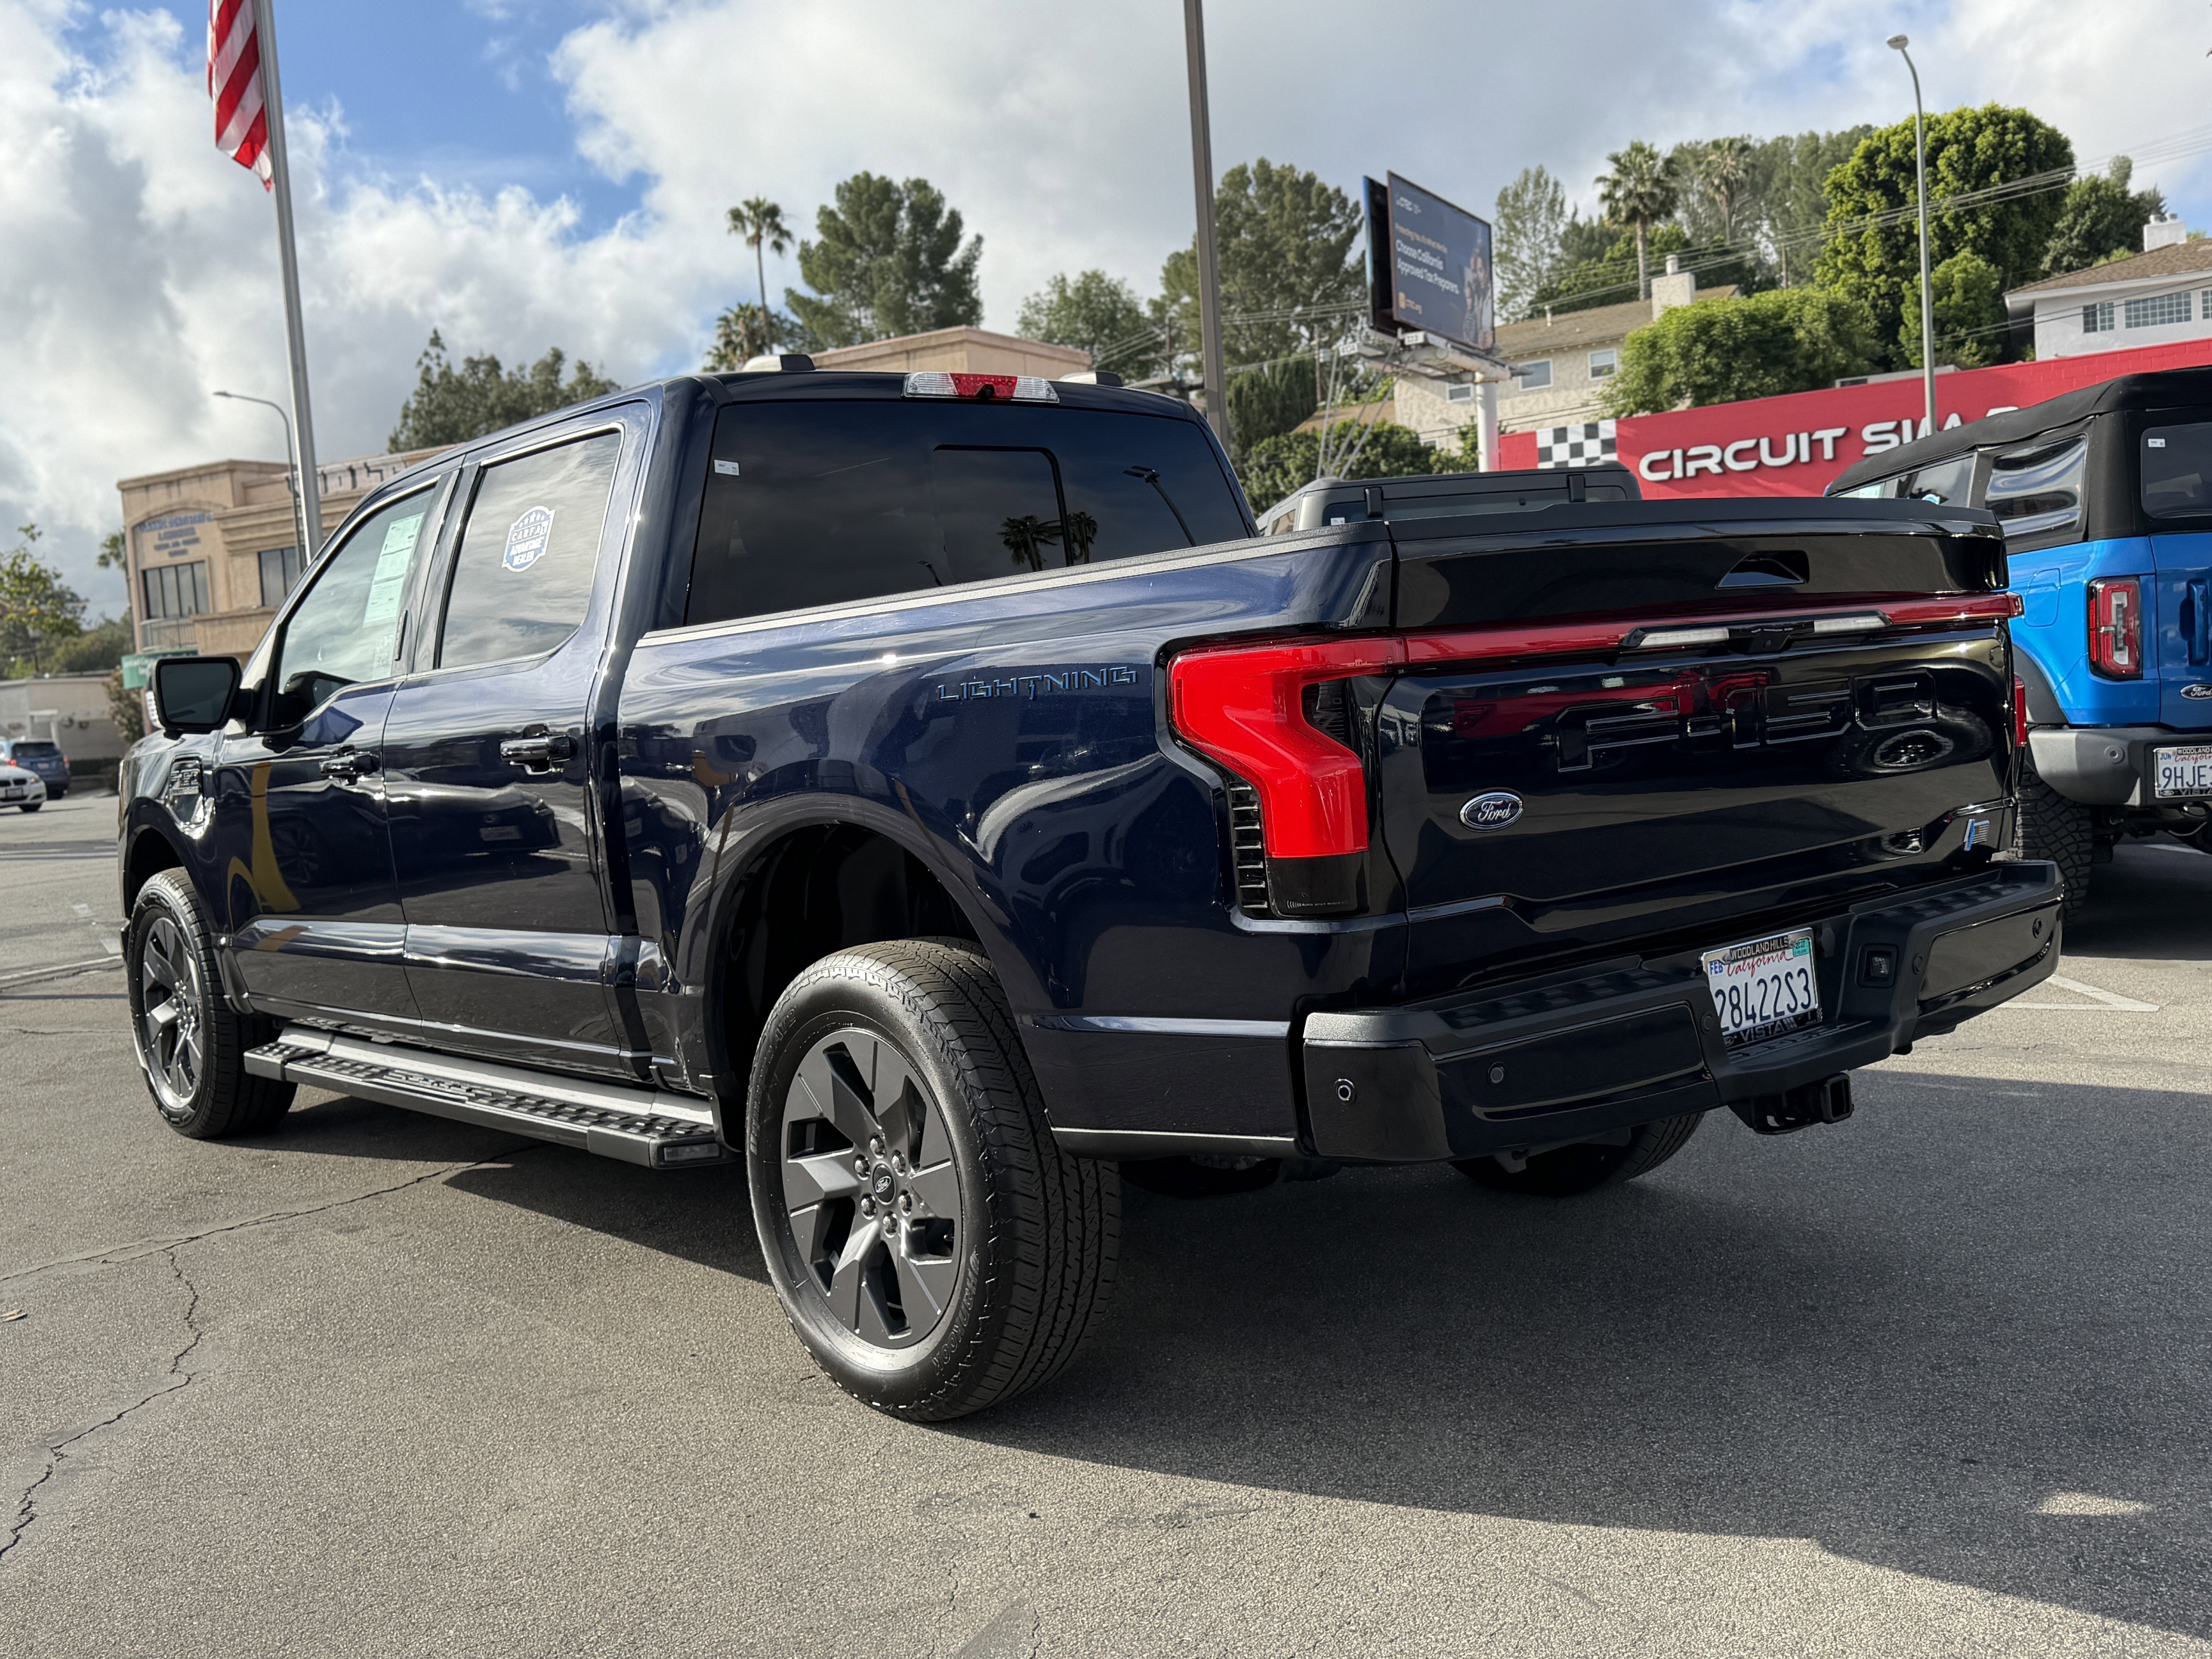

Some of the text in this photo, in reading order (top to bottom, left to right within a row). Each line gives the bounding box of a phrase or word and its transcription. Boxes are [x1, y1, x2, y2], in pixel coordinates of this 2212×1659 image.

[1638, 427, 1848, 481] CIRCUIT
[512, 521, 549, 542] CARFAX
[937, 666, 1137, 702] LIGHTNING
[1478, 800, 1511, 822] Ford
[1730, 937, 1789, 960] WOODLAND HILLS
[1710, 960, 1723, 975] FEB
[1726, 951, 1793, 977] California
[1715, 967, 1812, 1032] 28422S3
[1740, 1020, 1785, 1042] VISTA
